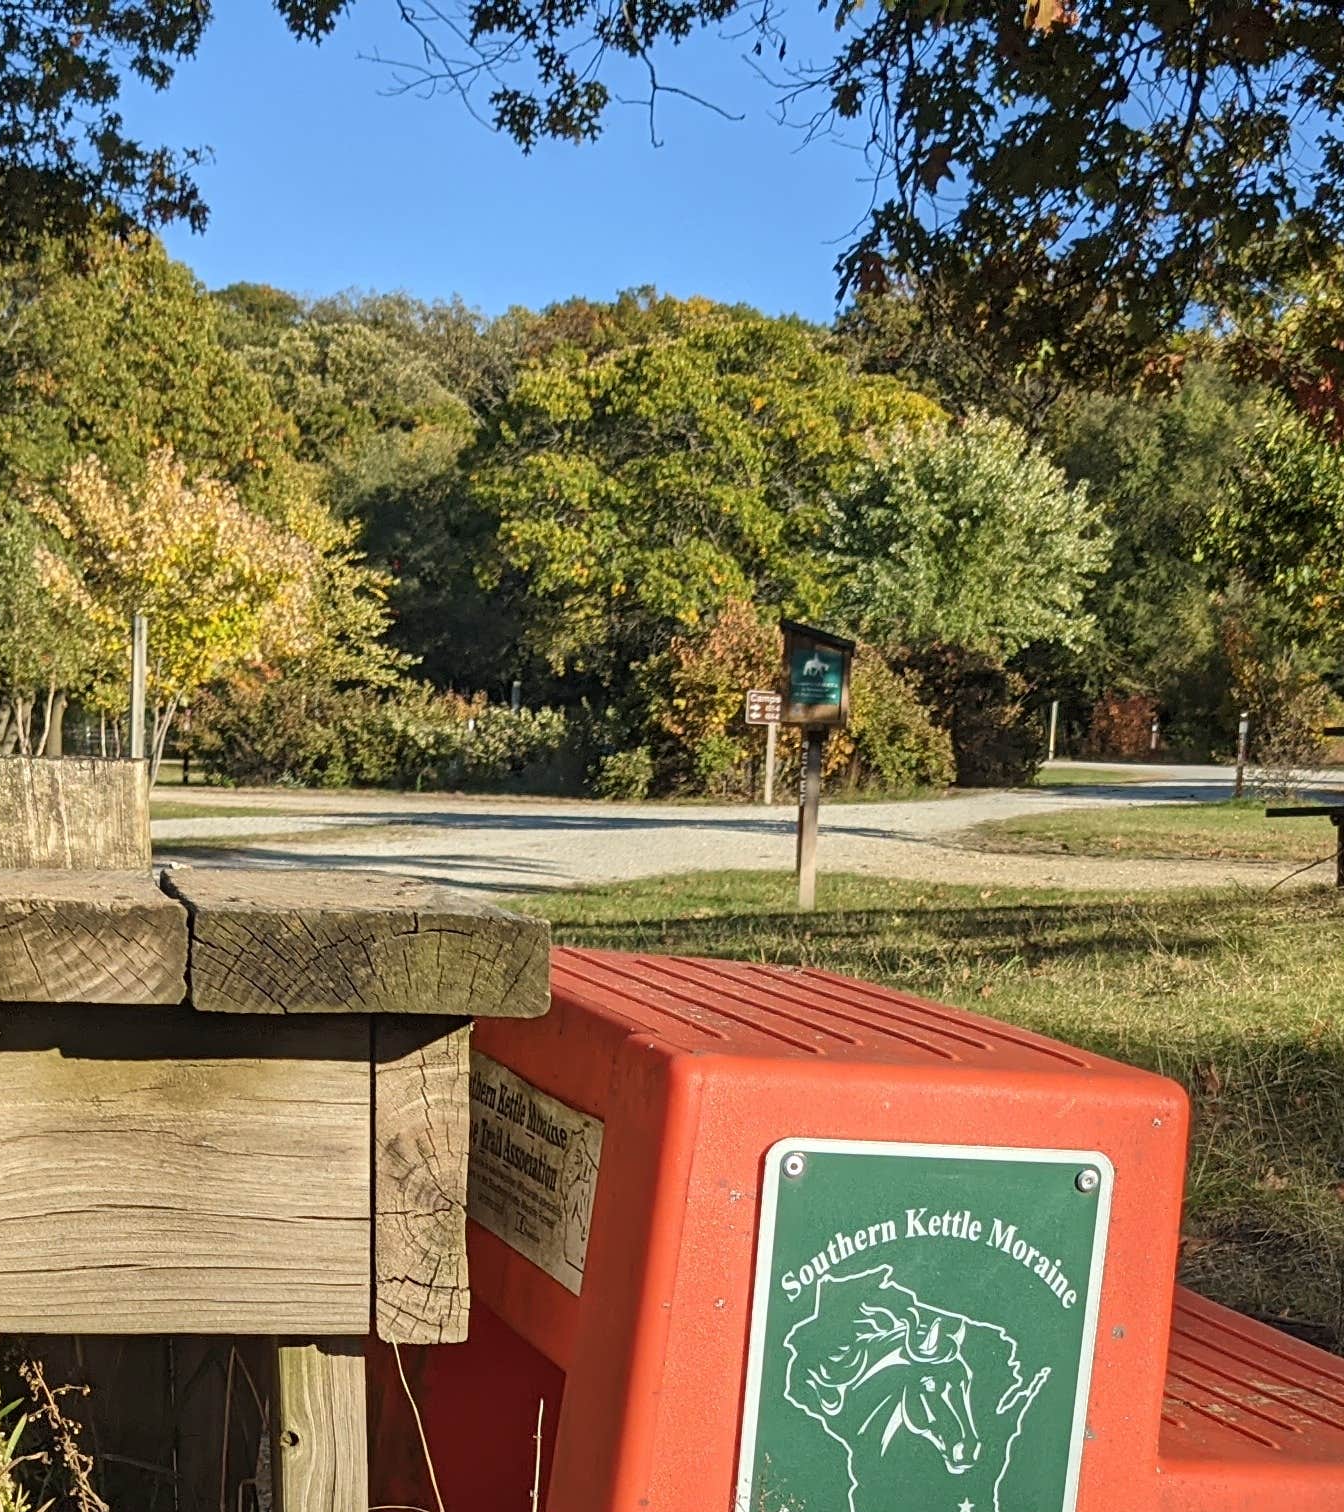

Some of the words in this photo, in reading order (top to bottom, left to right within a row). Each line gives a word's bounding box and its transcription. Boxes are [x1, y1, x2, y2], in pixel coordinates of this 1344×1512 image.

[497, 1082, 526, 1127] Kettle
[480, 1118, 502, 1157] Trail
[503, 1133, 557, 1192] Association
[781, 1219, 897, 1301] Southern
[905, 1208, 982, 1241] Kettle
[986, 1218, 1077, 1309] Moraine
